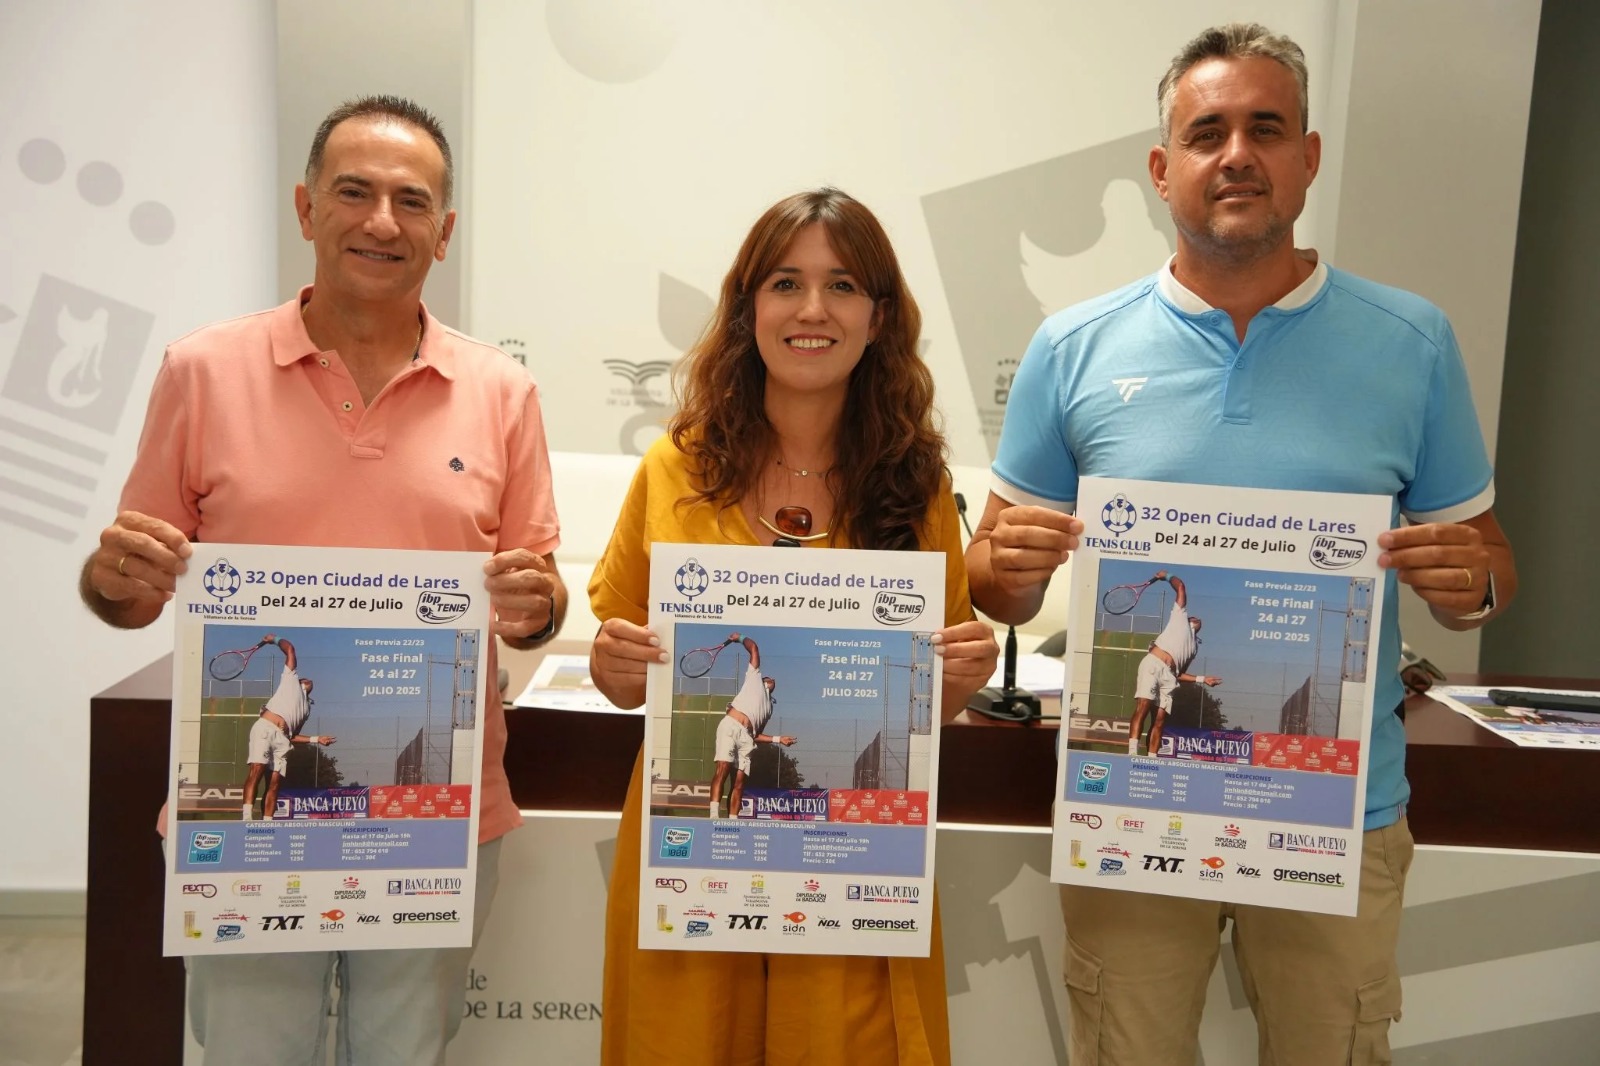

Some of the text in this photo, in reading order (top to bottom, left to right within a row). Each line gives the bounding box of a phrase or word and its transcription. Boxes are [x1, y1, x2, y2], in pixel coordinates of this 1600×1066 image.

[1141, 507, 1356, 534] 32 Open Ciudad de Lares
[1085, 537, 1151, 552] TENIS CLUB
[1155, 532, 1296, 553] Del 24 al 27 de Julio
[1316, 538, 1336, 549] ibp
[1332, 549, 1362, 558] TENIS
[246, 570, 459, 588] 32 Open Ciudad de Lares
[713, 570, 914, 589] 32 Open Ciudad de Lares
[1245, 580, 1316, 592] Fase Previa 22/23
[261, 596, 402, 612] Del 24 al 27 de Julio
[422, 594, 441, 604] ibp
[727, 594, 860, 611] Del 24 al 27 de Julio
[878, 594, 896, 605] ibp
[1250, 596, 1314, 610] Fase Final
[188, 604, 257, 615] TENIS CLUB
[437, 604, 466, 612] TENIS
[660, 602, 724, 614] TENIS CLUB
[893, 604, 922, 613] TENIS
[1258, 613, 1306, 625] 24 al 27
[1250, 630, 1310, 642] JULIO 2025
[362, 654, 422, 662] Fase Final
[821, 654, 880, 665] Fase Final
[370, 669, 416, 678] 24 al 27
[829, 671, 874, 680] 24 al 27
[362, 686, 420, 696] JULIO 2025
[822, 688, 878, 698] JULIO 2025
[1178, 736, 1212, 754] BANCA
[1215, 740, 1250, 756] PUEYO
[1168, 761, 1200, 769] ABSOLUTO
[1201, 764, 1238, 772] MASCULINO
[294, 797, 328, 812] BANCA
[332, 796, 366, 812] PUEYO
[758, 798, 790, 812] BANCA
[793, 798, 826, 814] PUEYO
[1124, 820, 1144, 828] RFET
[1287, 834, 1346, 850] BANCA PUEYO
[1144, 855, 1184, 873] TXT
[1237, 866, 1260, 876] NDL
[1274, 868, 1342, 884] greenset
[406, 878, 461, 890] BANCA PUEYO
[864, 885, 919, 898] BANCA PUEYO
[262, 916, 304, 930] TXT
[393, 910, 457, 924] greenset
[728, 914, 768, 930] TXT
[852, 918, 916, 930] greenset
